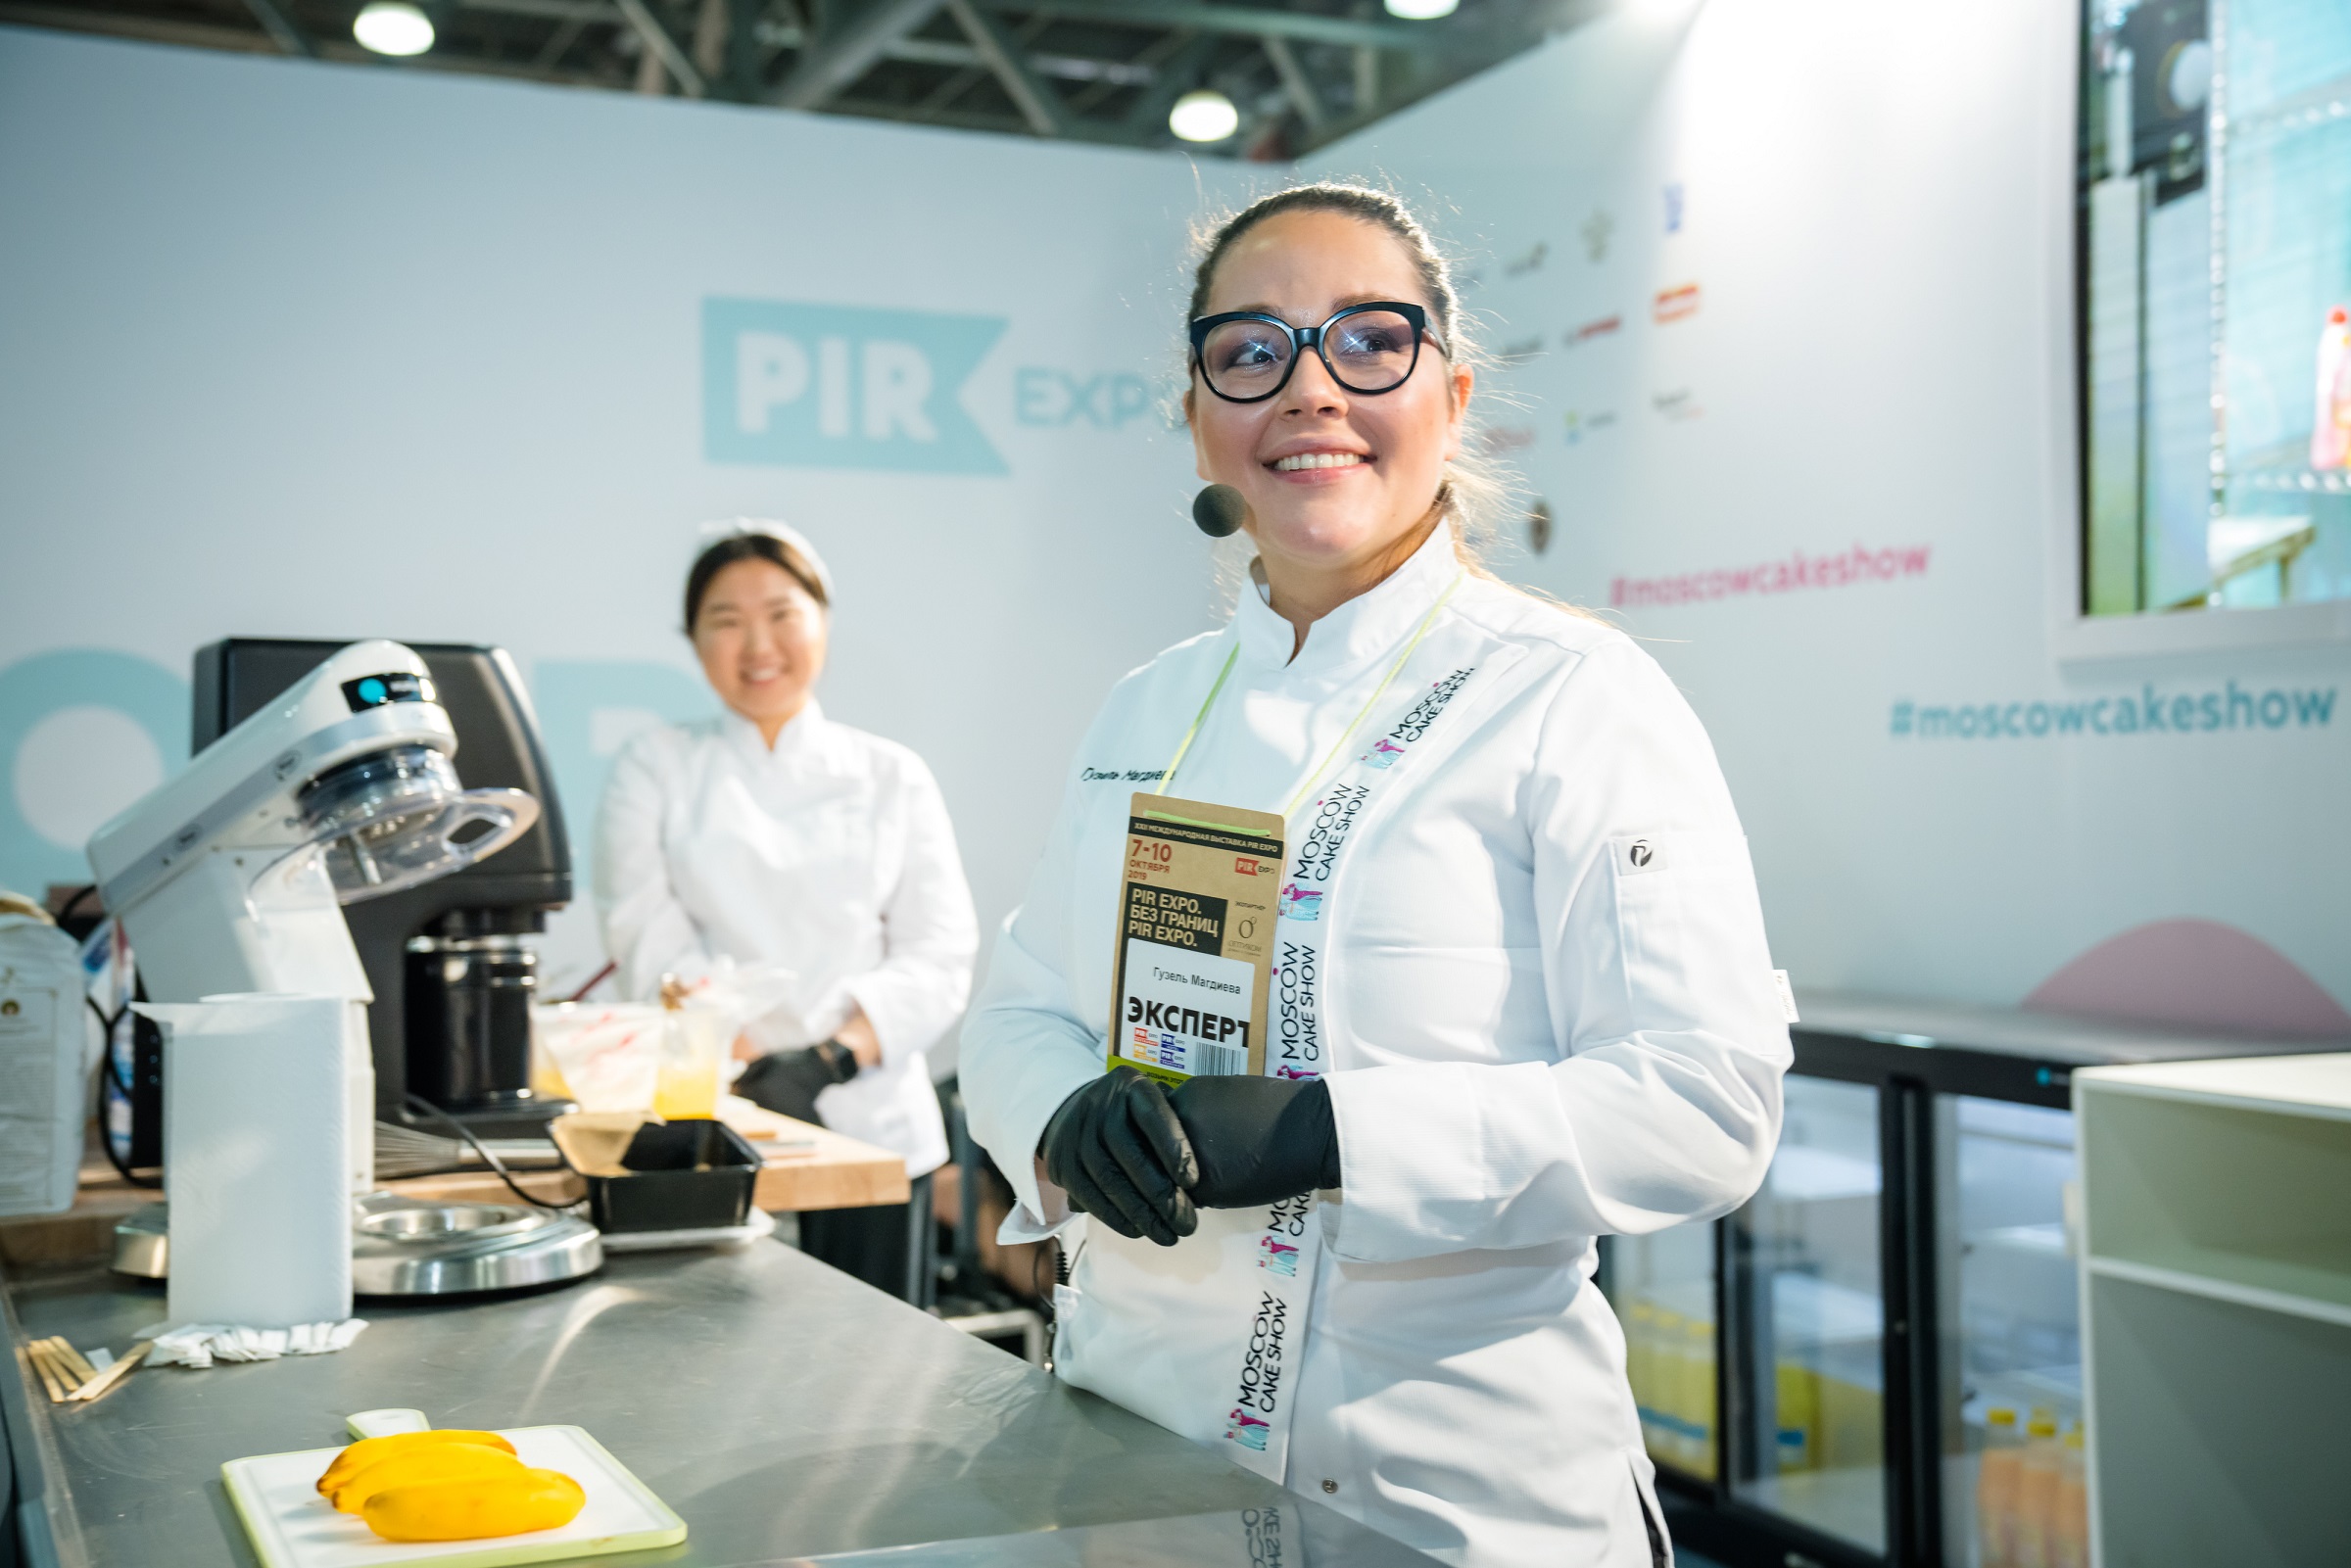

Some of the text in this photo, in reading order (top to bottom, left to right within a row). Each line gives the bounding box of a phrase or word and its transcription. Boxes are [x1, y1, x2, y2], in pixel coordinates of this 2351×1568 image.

[736, 329, 1182, 443] PIR EXP
[1609, 543, 1932, 609] #moscowcakeshow
[1406, 706, 1444, 742] CAKE
[1889, 679, 2337, 741] #moscowcakeshow
[1131, 838, 1173, 863] 7-10
[1210, 833, 1247, 847] ВЫСТАВКА
[1247, 841, 1260, 850] PIR
[1260, 843, 1278, 852] EXPO
[1293, 783, 1353, 879] MOSCOW
[1316, 784, 1370, 881] CAKE SHOW
[1128, 870, 1147, 880] 2019
[1129, 859, 1171, 874] ОКТЯБРЯ
[1237, 860, 1275, 875] PIR EXPO
[1130, 904, 1219, 937] БЕЗ ГРАНИЦ
[1131, 887, 1202, 914] PIR EXPO.
[1128, 921, 1198, 947] PIR EXPO.
[1153, 967, 1241, 995] Гузель Магдиева
[1280, 941, 1301, 1060] MOSCOW
[1300, 944, 1319, 1062] CAKE SHOW
[1128, 996, 1250, 1048] ЭКСПЕРТ
[1238, 1290, 1273, 1407] MOSCOW
[1260, 1298, 1287, 1412] CAKE SHOW
